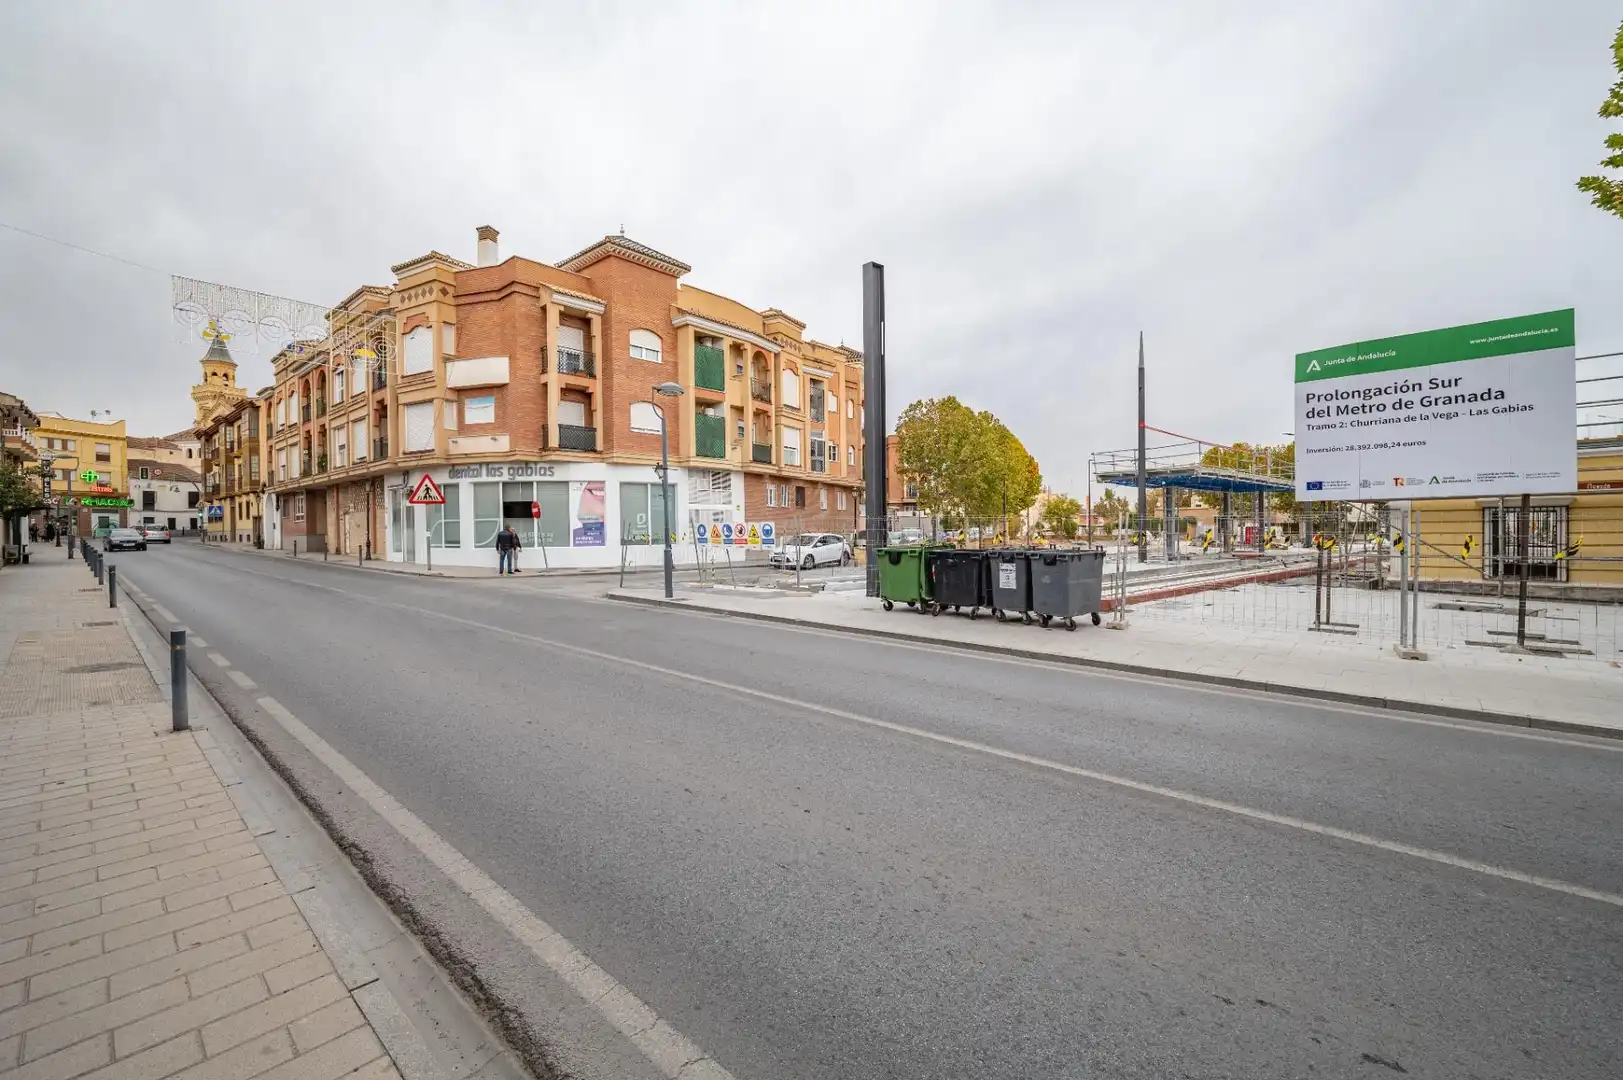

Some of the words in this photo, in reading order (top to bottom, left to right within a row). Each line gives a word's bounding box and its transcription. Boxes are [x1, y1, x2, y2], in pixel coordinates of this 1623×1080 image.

[1357, 349, 1396, 361] Andalucía
[1306, 379, 1423, 404] Prolongación
[1429, 376, 1462, 390] Sur
[1306, 405, 1332, 419] del
[1336, 402, 1387, 416] Metro
[1392, 398, 1415, 411] de
[1420, 387, 1506, 407] Granada
[1306, 423, 1337, 431] Tramo
[1339, 421, 1348, 429] 2:
[1350, 416, 1401, 428] Churriana
[1404, 414, 1417, 423] de
[1420, 413, 1430, 421] la
[1432, 411, 1459, 421] Vega
[1469, 408, 1489, 417] Las
[1492, 403, 1535, 415] Gabias
[1306, 446, 1344, 455] Inversión:
[1403, 440, 1427, 448] euros
[448, 463, 483, 479] dental
[485, 463, 504, 478] las
[507, 461, 556, 480] gabias
